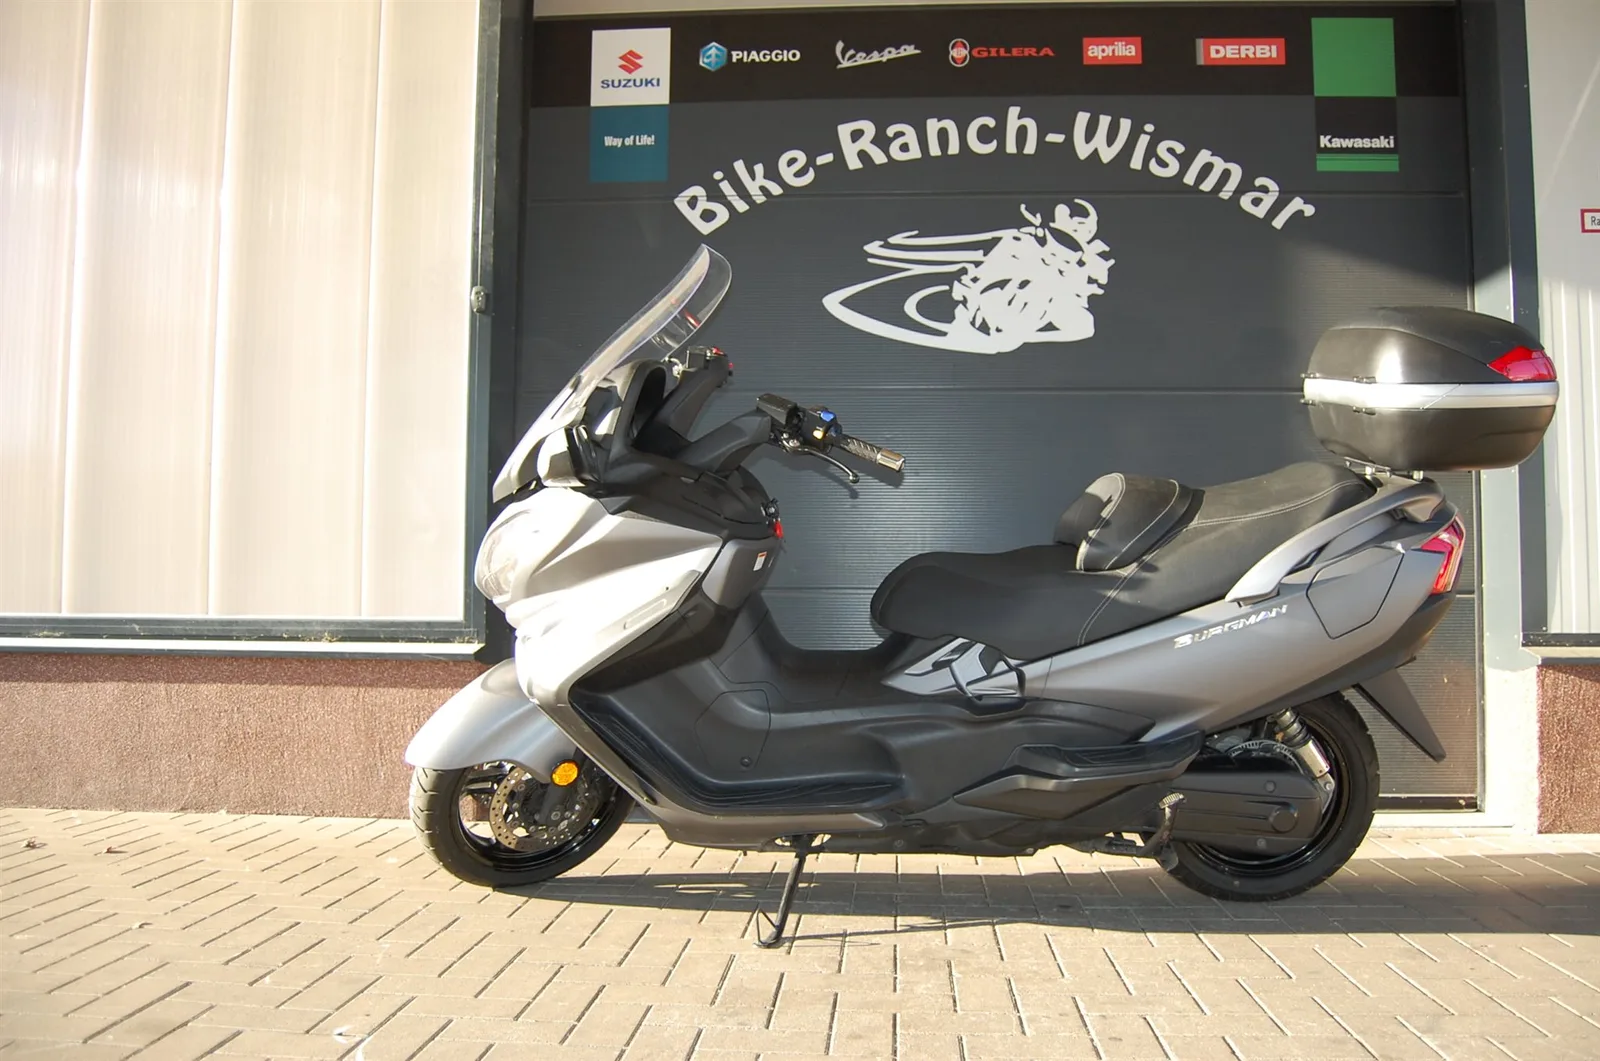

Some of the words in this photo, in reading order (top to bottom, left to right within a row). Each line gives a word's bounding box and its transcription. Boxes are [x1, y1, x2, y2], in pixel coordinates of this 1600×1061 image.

[731, 49, 801, 63] PIAGGIO
[835, 40, 921, 69] Vespa
[971, 46, 1055, 58] GILERA
[1087, 42, 1136, 60] aprilia
[1209, 44, 1278, 59] DERBI
[600, 77, 661, 89] SUZUKI
[604, 136, 623, 148] Way
[624, 135, 635, 146] of
[635, 134, 656, 146] Life!
[1319, 134, 1396, 149] Kawasaki
[673, 105, 1316, 236] Bike-Ranch-Wismar
